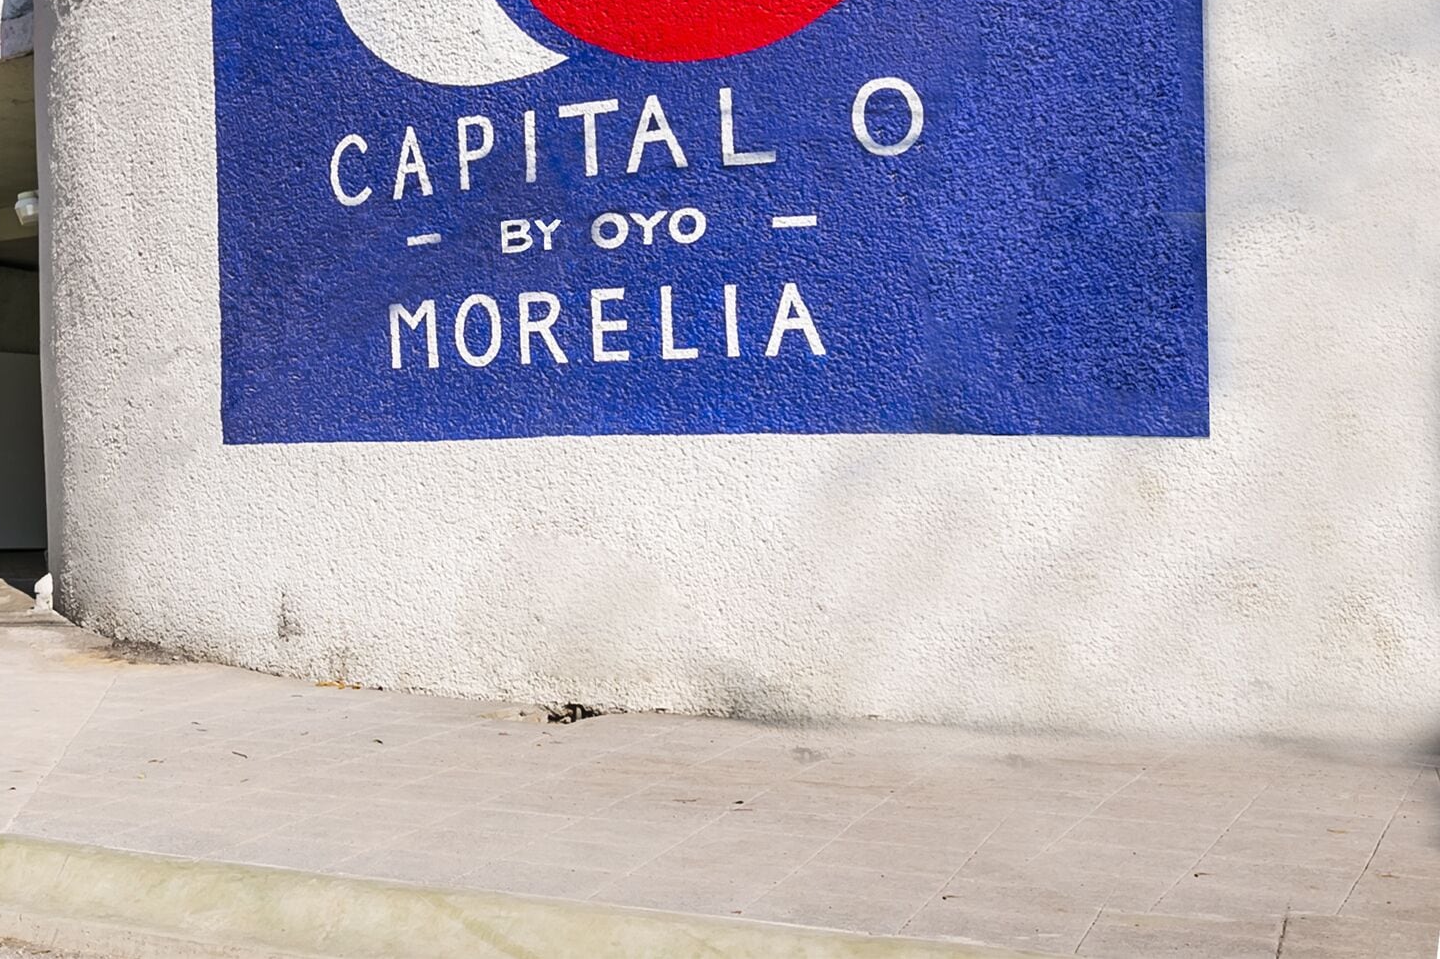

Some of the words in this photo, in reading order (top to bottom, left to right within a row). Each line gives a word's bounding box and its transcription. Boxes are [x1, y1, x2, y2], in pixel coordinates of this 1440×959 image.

[330, 88, 776, 206] CAPITAL
[852, 77, 924, 156] O
[500, 219, 562, 254] BY
[591, 208, 707, 249] OYO
[389, 284, 826, 369] MORELIA
